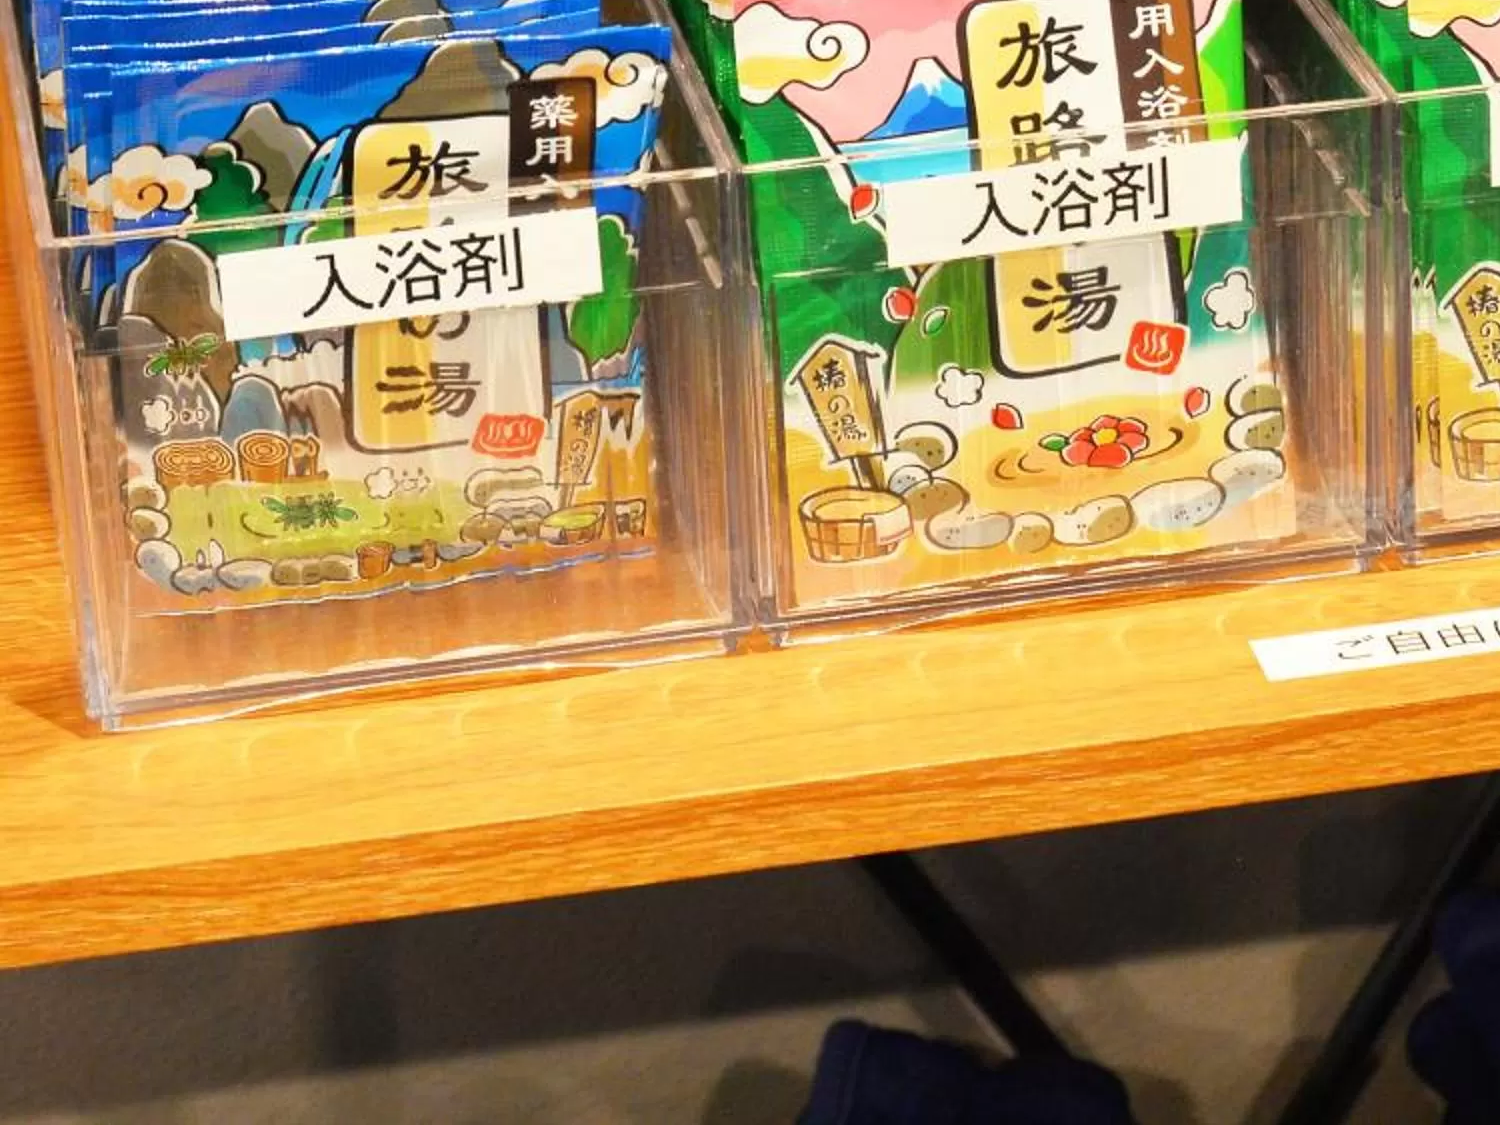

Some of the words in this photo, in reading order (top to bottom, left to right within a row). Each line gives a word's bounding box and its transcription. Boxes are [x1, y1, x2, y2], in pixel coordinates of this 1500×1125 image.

[960, 156, 1170, 245] 入浴剤
[302, 226, 524, 320] 入浴剤
